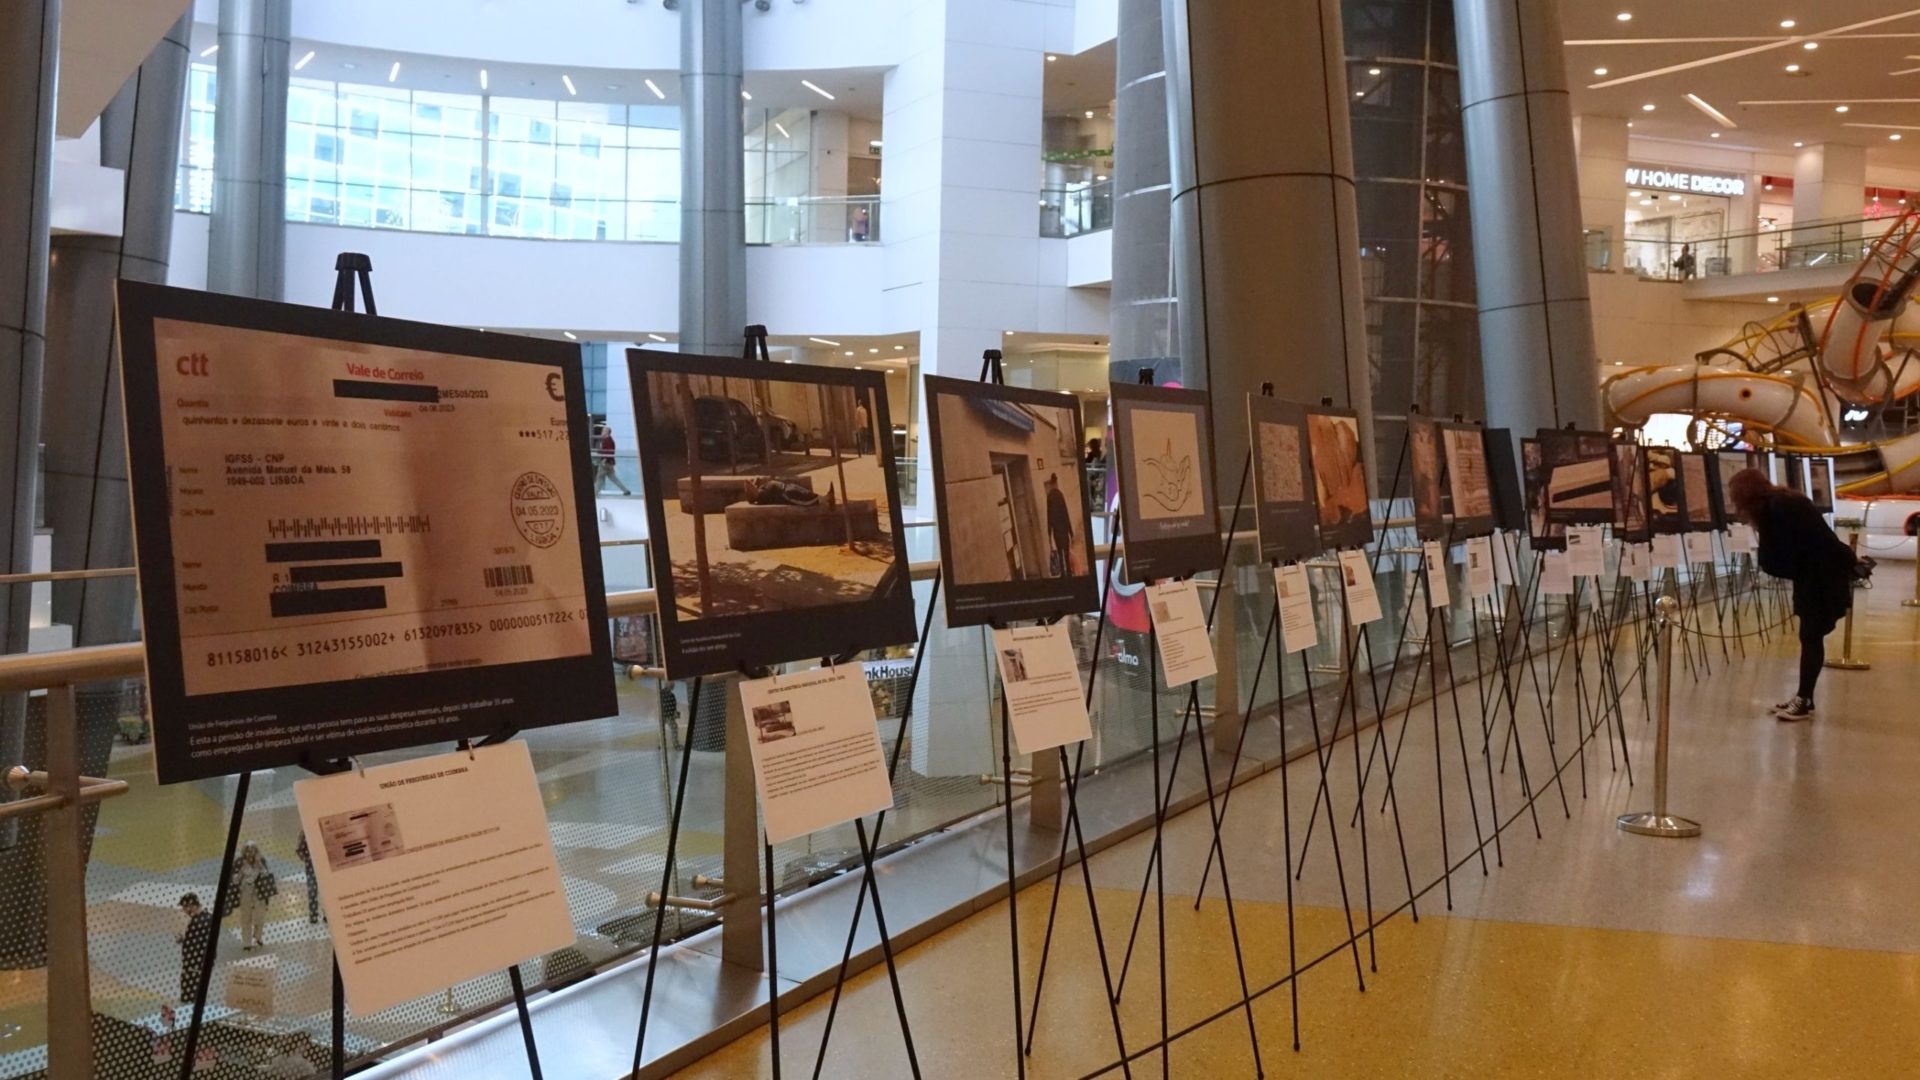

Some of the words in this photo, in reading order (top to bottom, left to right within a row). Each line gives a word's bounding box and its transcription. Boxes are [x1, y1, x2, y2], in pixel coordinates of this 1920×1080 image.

[1641, 170, 1689, 190] HOME
[1690, 175, 1745, 195] DECOR
[176, 353, 208, 376] ctt
[346, 363, 370, 377] Vale
[372, 367, 385, 378] de
[387, 368, 424, 381] Correio
[225, 453, 253, 463] IGFSS
[265, 454, 285, 463] CNP
[225, 465, 262, 475] Avenida
[266, 465, 297, 474] Manuel
[301, 465, 312, 474] da
[270, 475, 304, 485] LISBOA
[207, 645, 288, 667] 81158016<
[297, 632, 395, 656] 31243155002+
[196, 736, 211, 745] esta
[287, 725, 301, 734] que
[302, 723, 316, 731] uma
[317, 720, 339, 730] pessoa
[354, 715, 368, 725] para
[390, 709, 416, 720] despesas
[442, 704, 460, 714] depois
[191, 749, 212, 758] como
[214, 743, 253, 756] empregada
[254, 741, 263, 749] de
[265, 737, 291, 749] limpeza
[346, 729, 354, 737] de
[415, 718, 437, 728] durante
